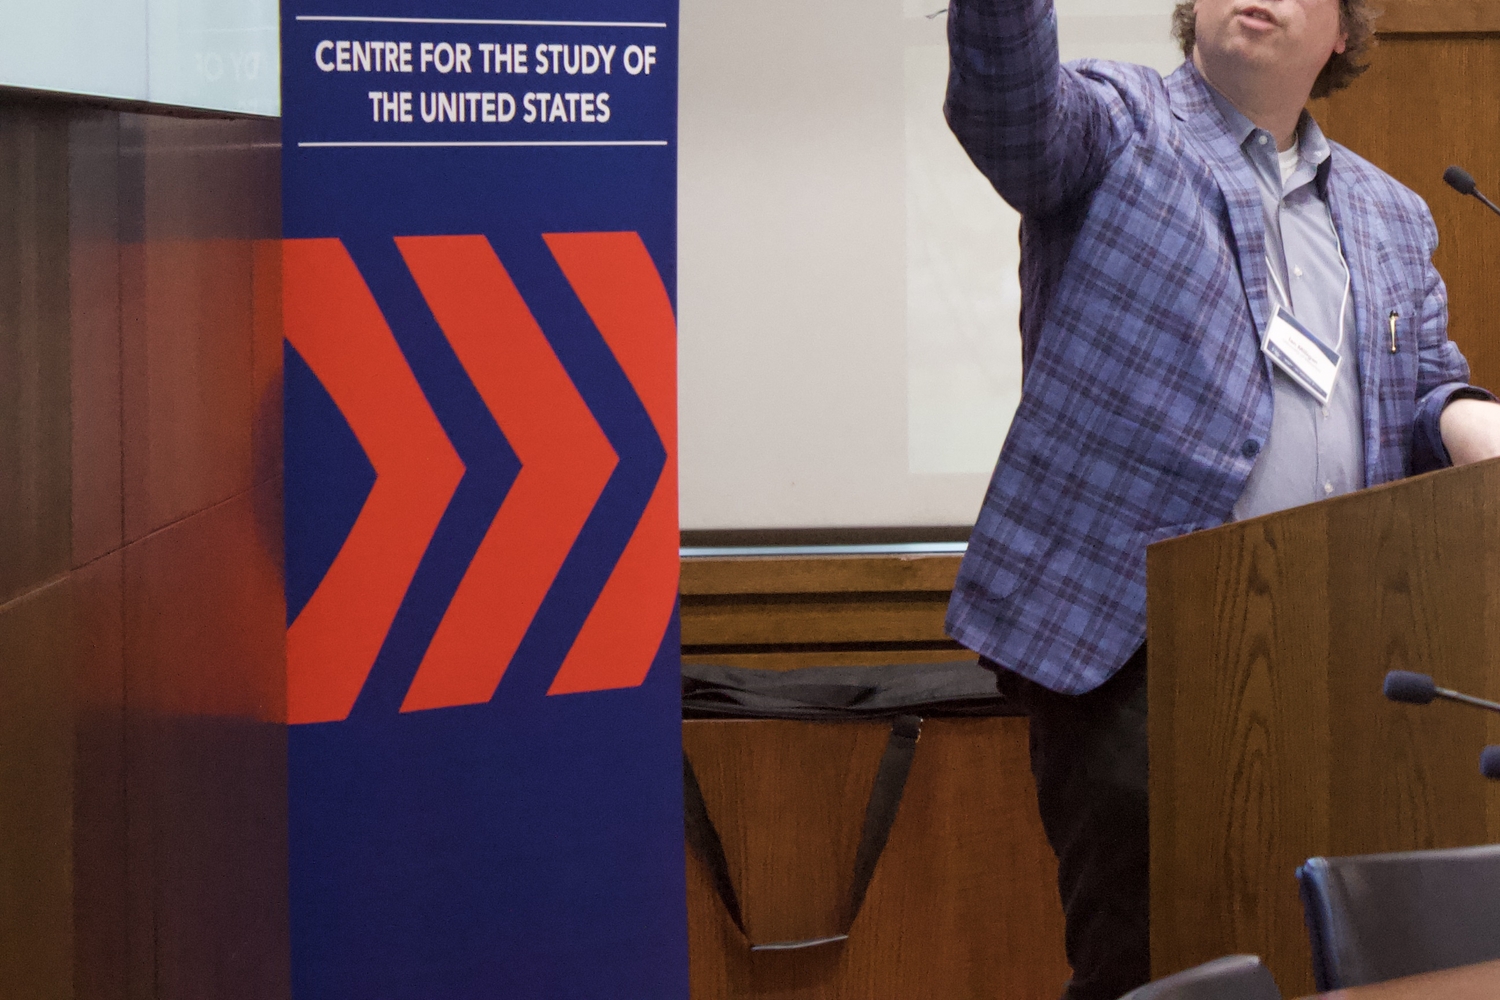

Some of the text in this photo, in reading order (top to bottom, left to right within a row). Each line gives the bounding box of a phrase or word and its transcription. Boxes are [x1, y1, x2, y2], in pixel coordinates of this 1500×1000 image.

[315, 39, 657, 76] CENTRE FOR THE STUDY OF
[368, 91, 611, 123] THE UNITED STATES
